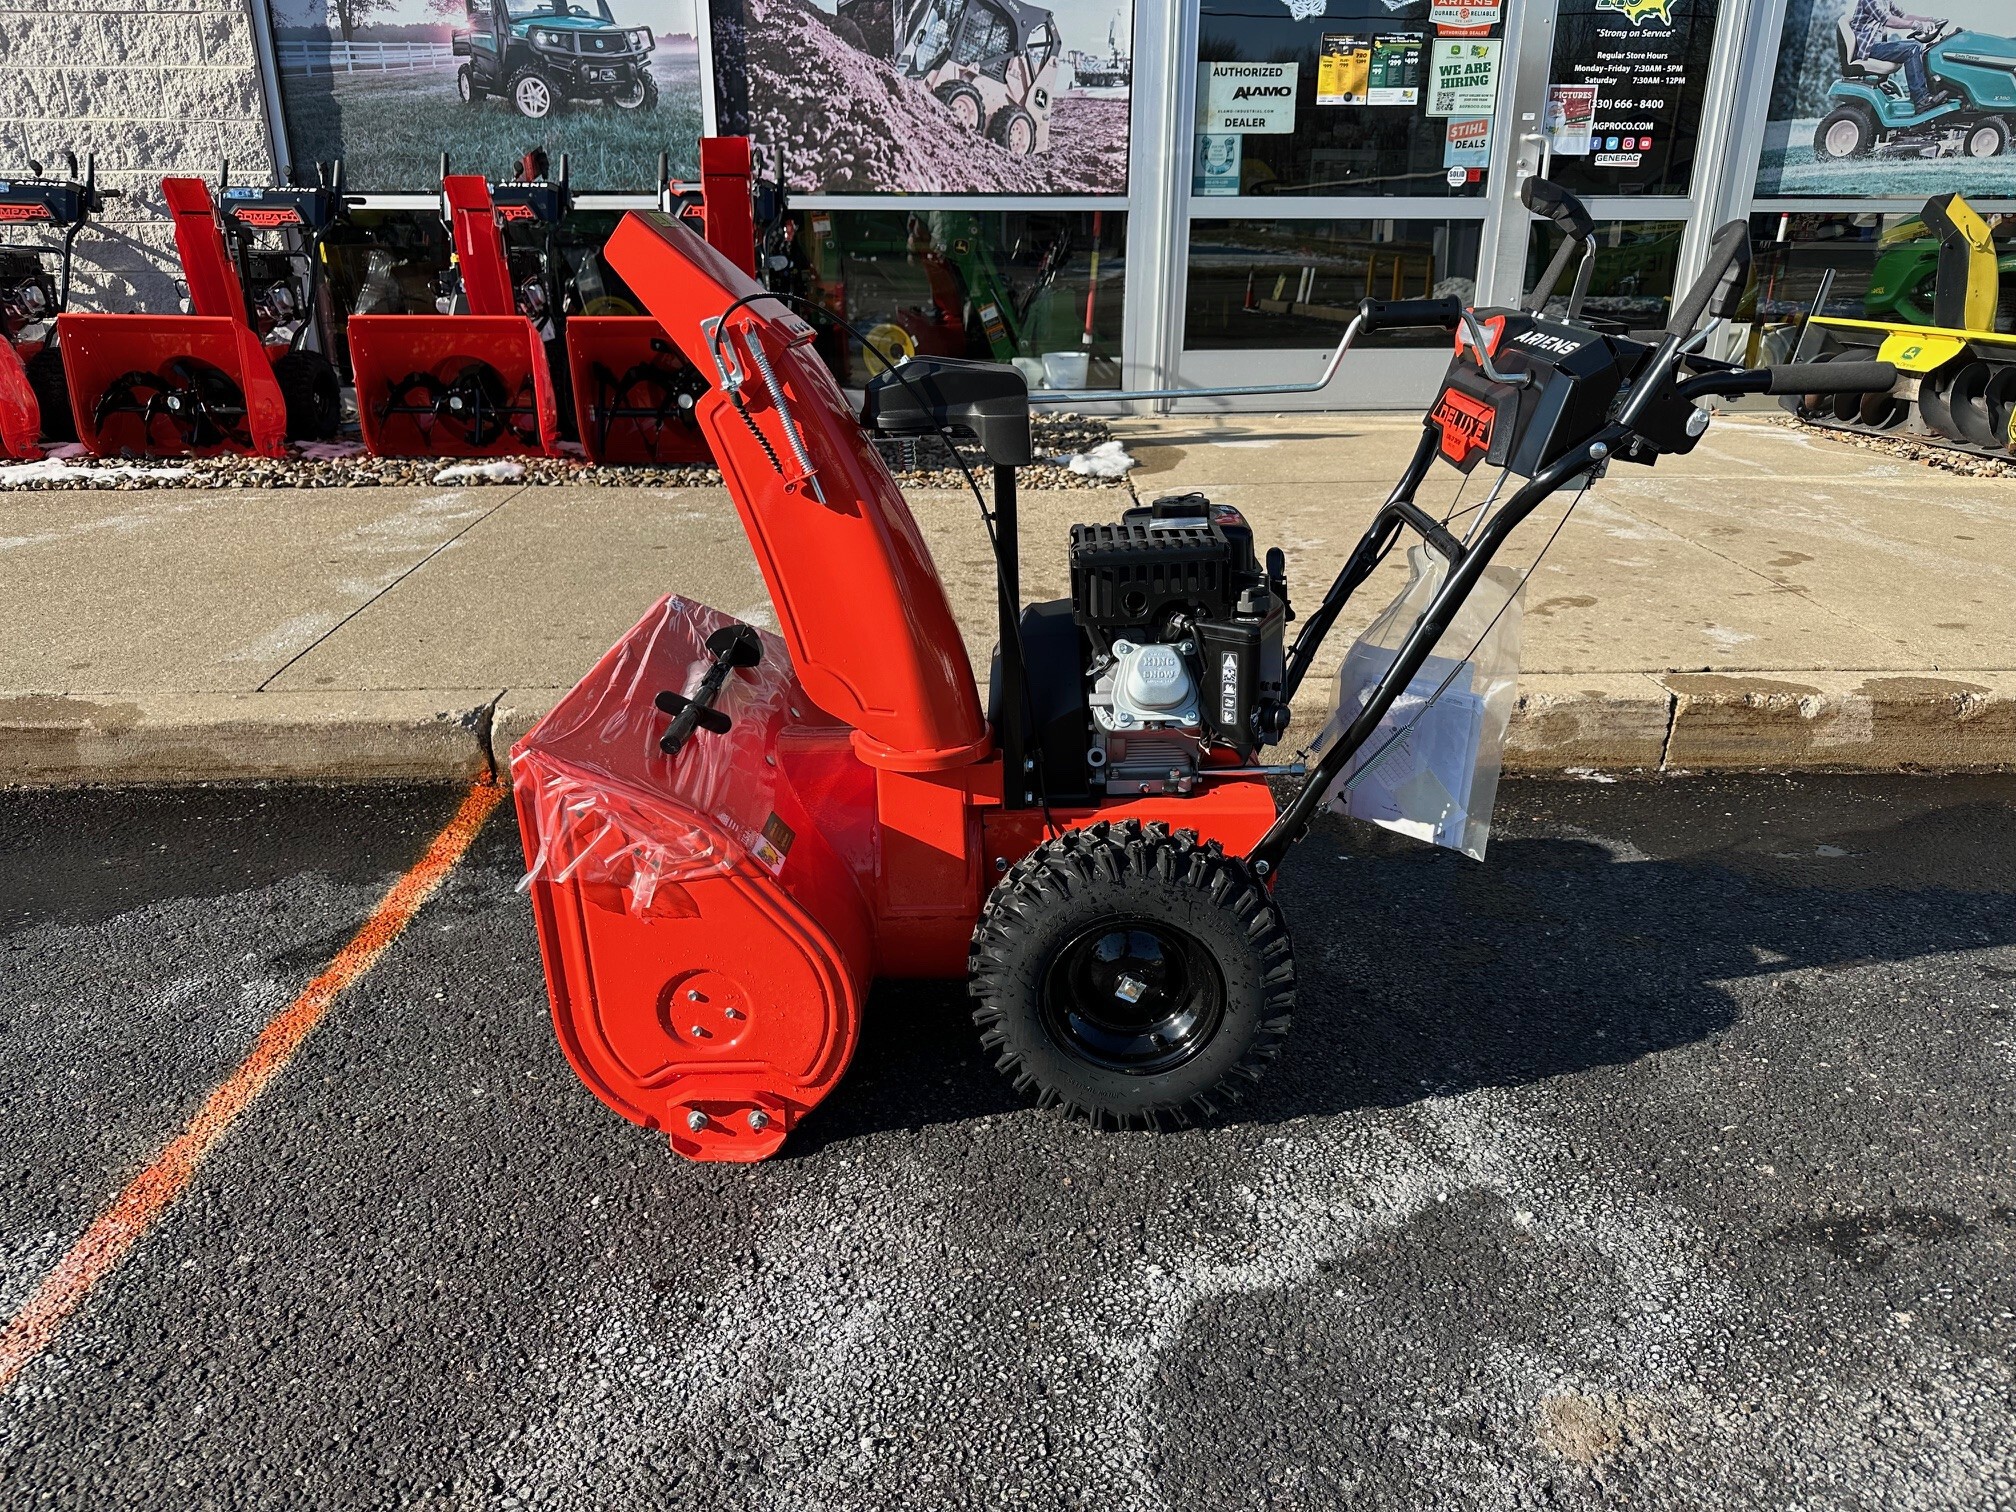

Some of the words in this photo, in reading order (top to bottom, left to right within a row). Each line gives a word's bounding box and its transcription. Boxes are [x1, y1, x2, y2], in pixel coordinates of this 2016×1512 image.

[1596, 29, 1627, 39] "Strong
[1642, 29, 1676, 37] Service"
[1597, 52, 1625, 61] Regular
[1626, 52, 1646, 60] Store
[1646, 52, 1668, 60] Hours
[1213, 67, 1283, 77] AUTHORIZED
[1439, 64, 1461, 76] WE
[1464, 62, 1491, 75] ARE
[1440, 75, 1489, 89] HIRING
[1585, 76, 1618, 85] Saturday
[1232, 86, 1292, 101] ALAMO
[1553, 91, 1592, 99] PICTURES
[1588, 99, 1612, 110] (330)
[1614, 99, 1633, 108] 666
[1639, 99, 1664, 108] 8400
[1225, 118, 1266, 127] DEALER
[1592, 122, 1654, 131] AGPROCO.COM
[1450, 122, 1485, 137] STIHL
[1455, 139, 1486, 149] DEALS
[1449, 170, 1465, 178] SOLID
[238, 213, 299, 222] COMPACT
[505, 210, 531, 218] ACT
[1513, 330, 1581, 355] ARIENS
[1438, 404, 1487, 442] DELUXE
[1143, 657, 1175, 667] KING
[1143, 671, 1175, 679] SNOW
